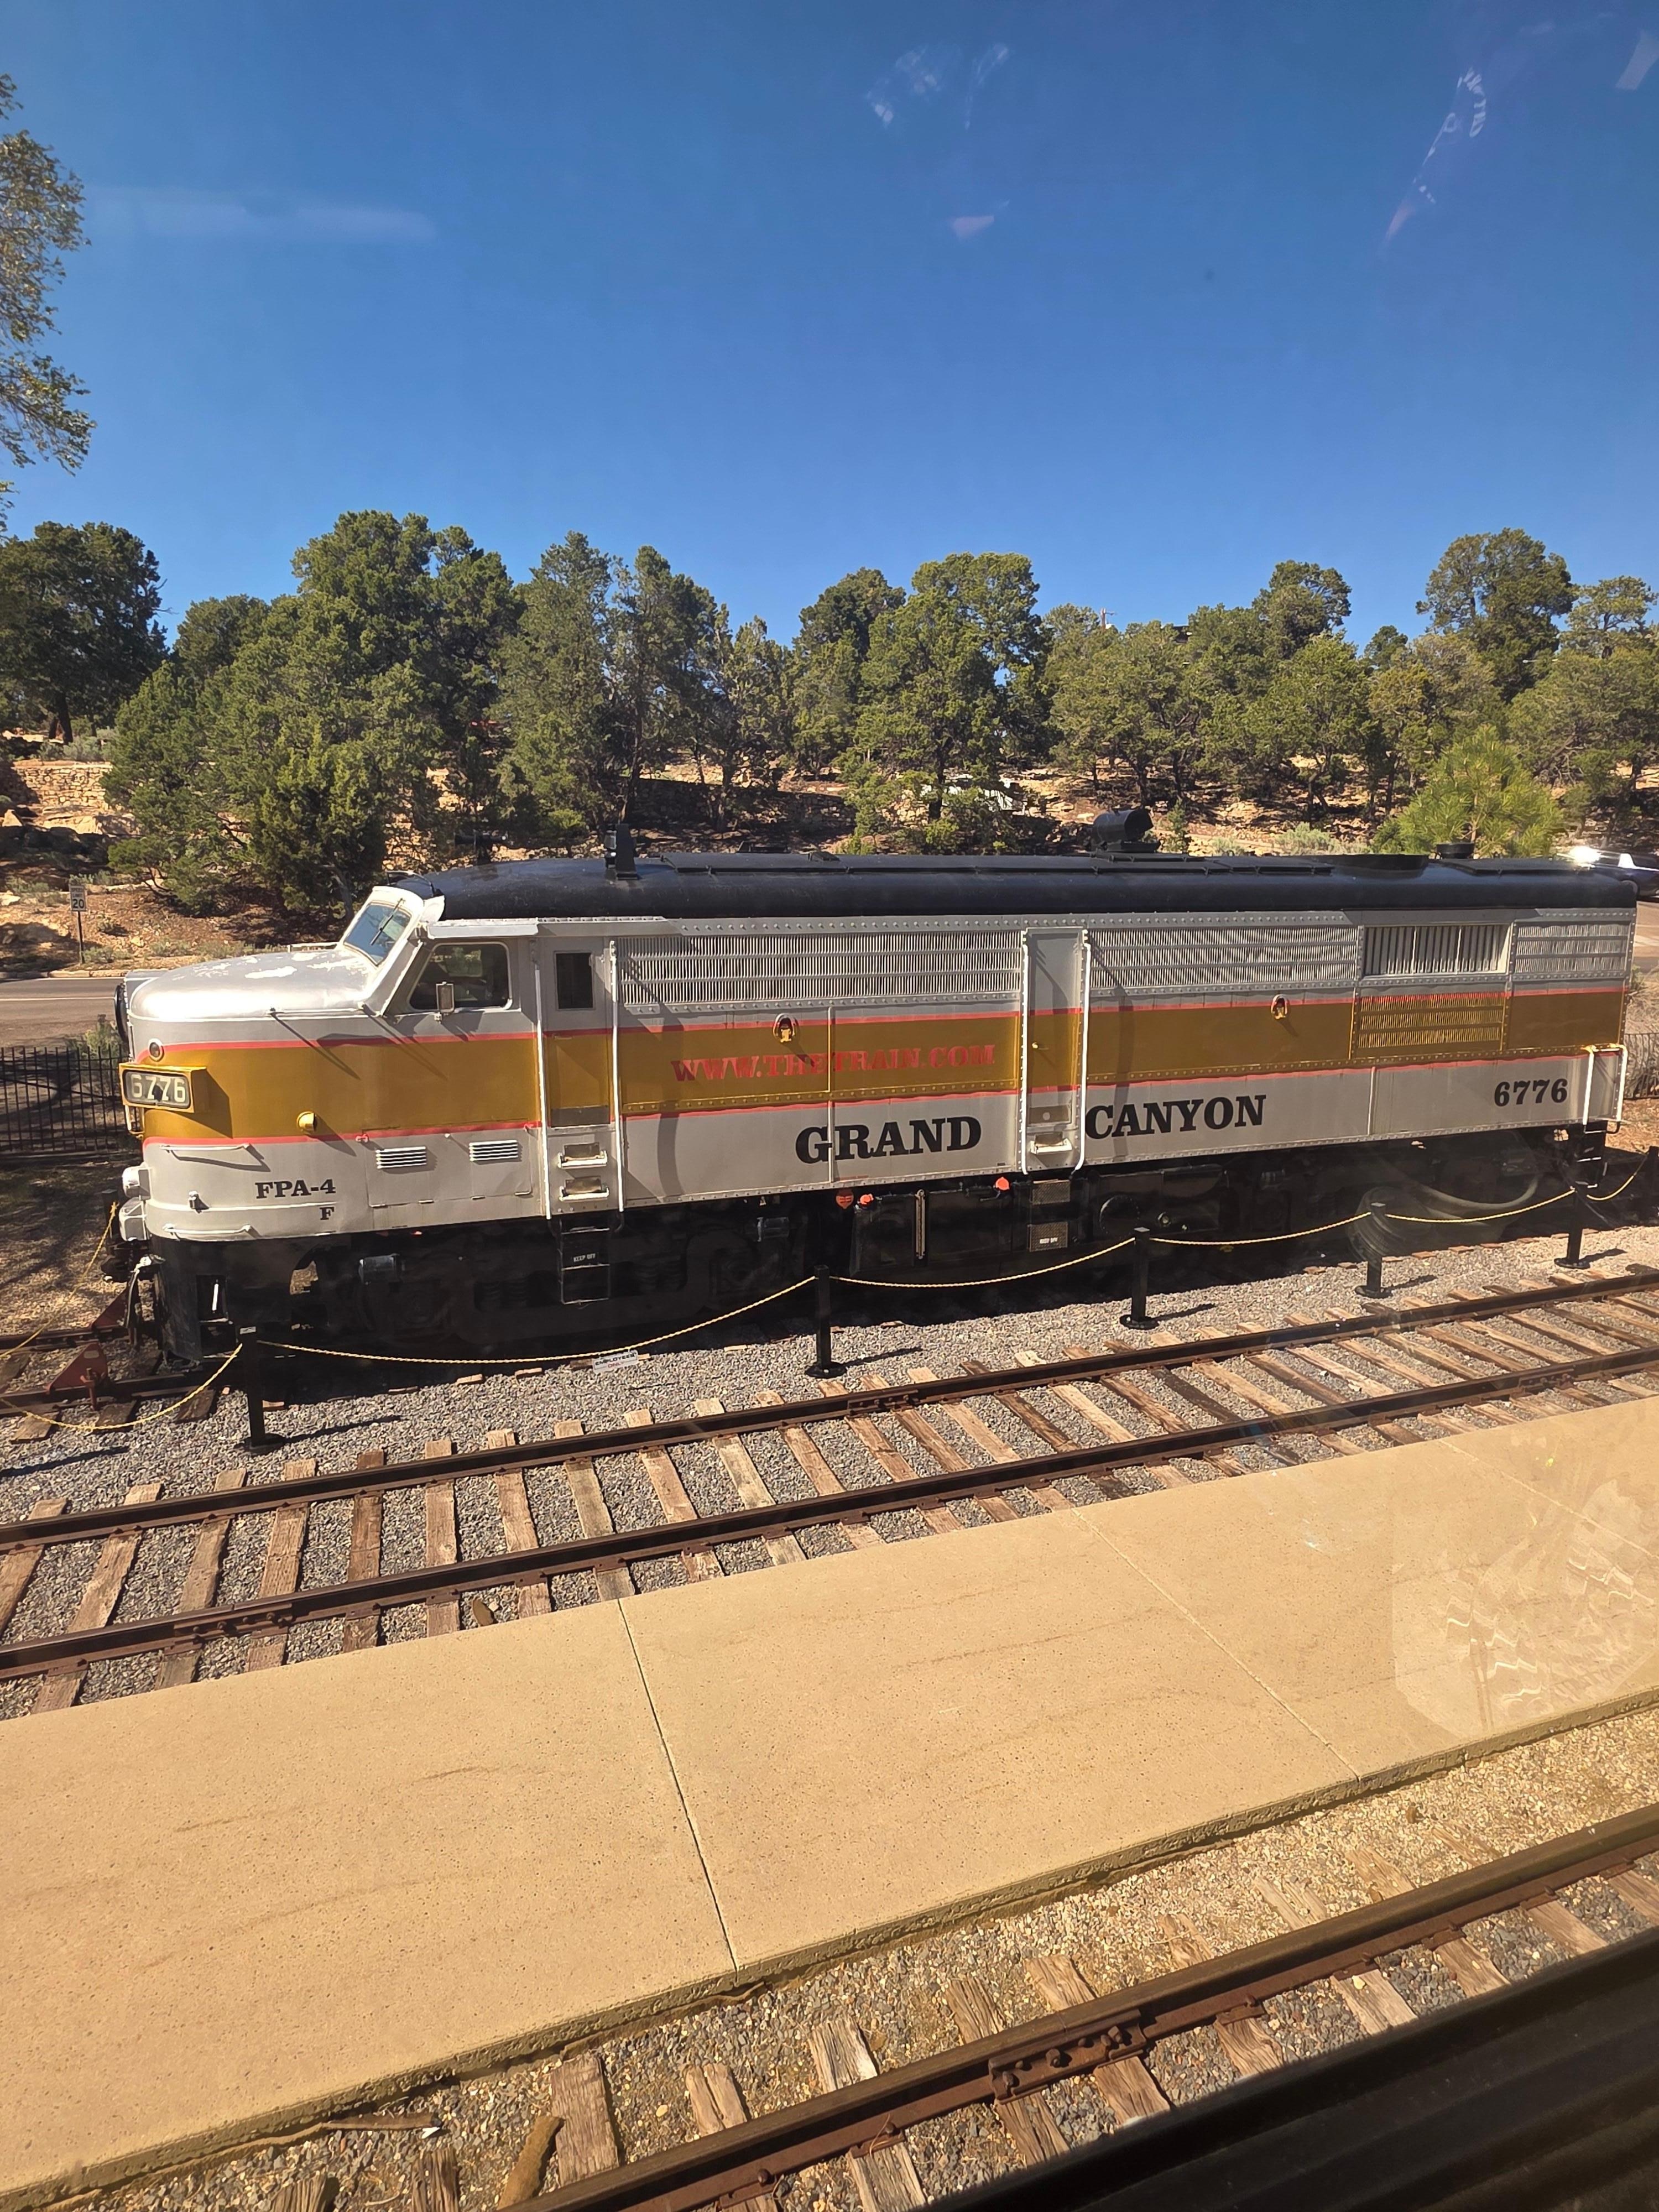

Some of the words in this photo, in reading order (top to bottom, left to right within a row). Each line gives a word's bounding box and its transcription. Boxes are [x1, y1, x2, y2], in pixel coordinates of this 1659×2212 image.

[72, 899, 84, 908] 20
[670, 1045, 995, 1081] WWW.THETRAIN.COM
[131, 1074, 186, 1103] 6776
[1494, 1078, 1568, 1107] 6776
[795, 1116, 982, 1164] GRAND
[1085, 1094, 1266, 1139] CANYON
[254, 1178, 336, 1199] FPA-4
[320, 1207, 335, 1220] F
